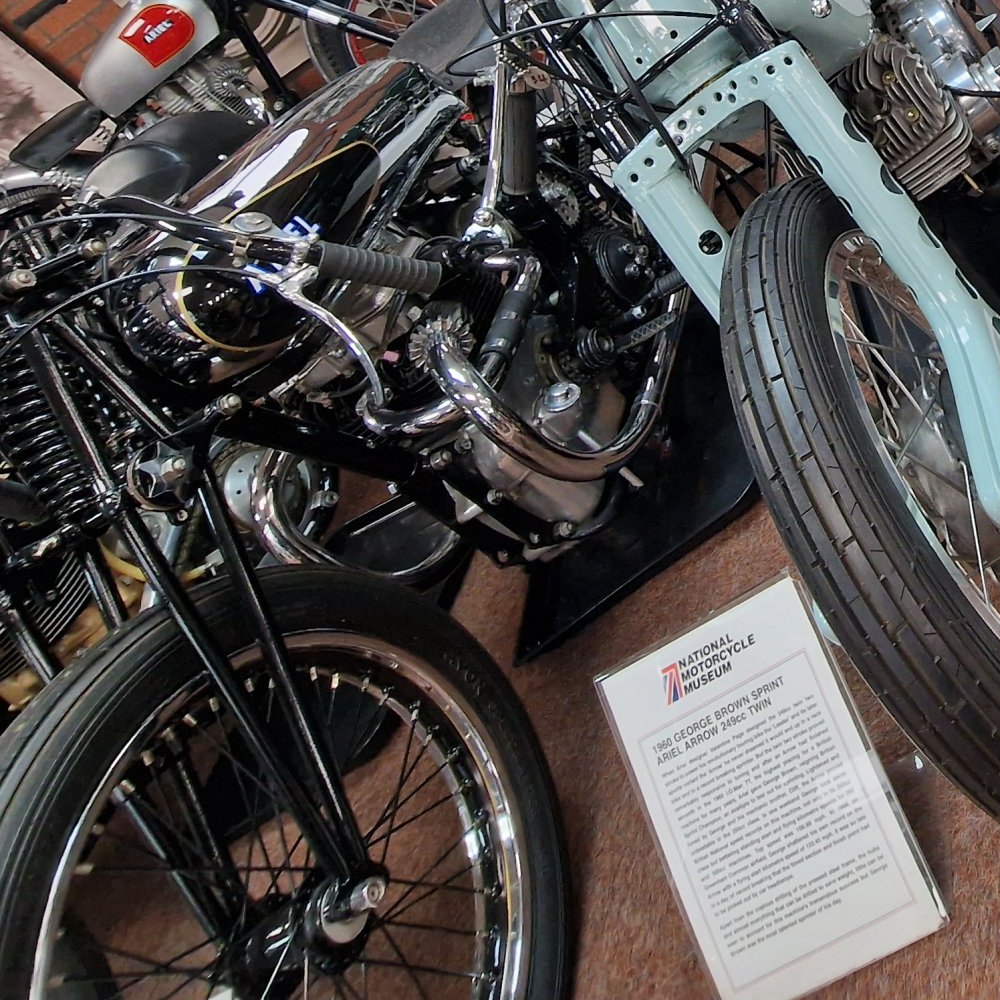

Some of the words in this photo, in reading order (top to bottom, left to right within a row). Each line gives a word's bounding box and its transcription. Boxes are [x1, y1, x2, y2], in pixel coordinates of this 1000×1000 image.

[677, 632, 734, 669] NATIONAL
[681, 633, 757, 683] MOTORCYCLE
[683, 660, 733, 696] MUSEUM
[652, 737, 672, 754] 1960
[674, 715, 713, 742] GEORGE
[714, 695, 750, 720] BROWN
[750, 676, 783, 700] SPRINT
[657, 746, 684, 766] ARIEL
[685, 725, 718, 751] ARROW
[720, 712, 746, 731] 249cc
[747, 696, 772, 715] TWIN
